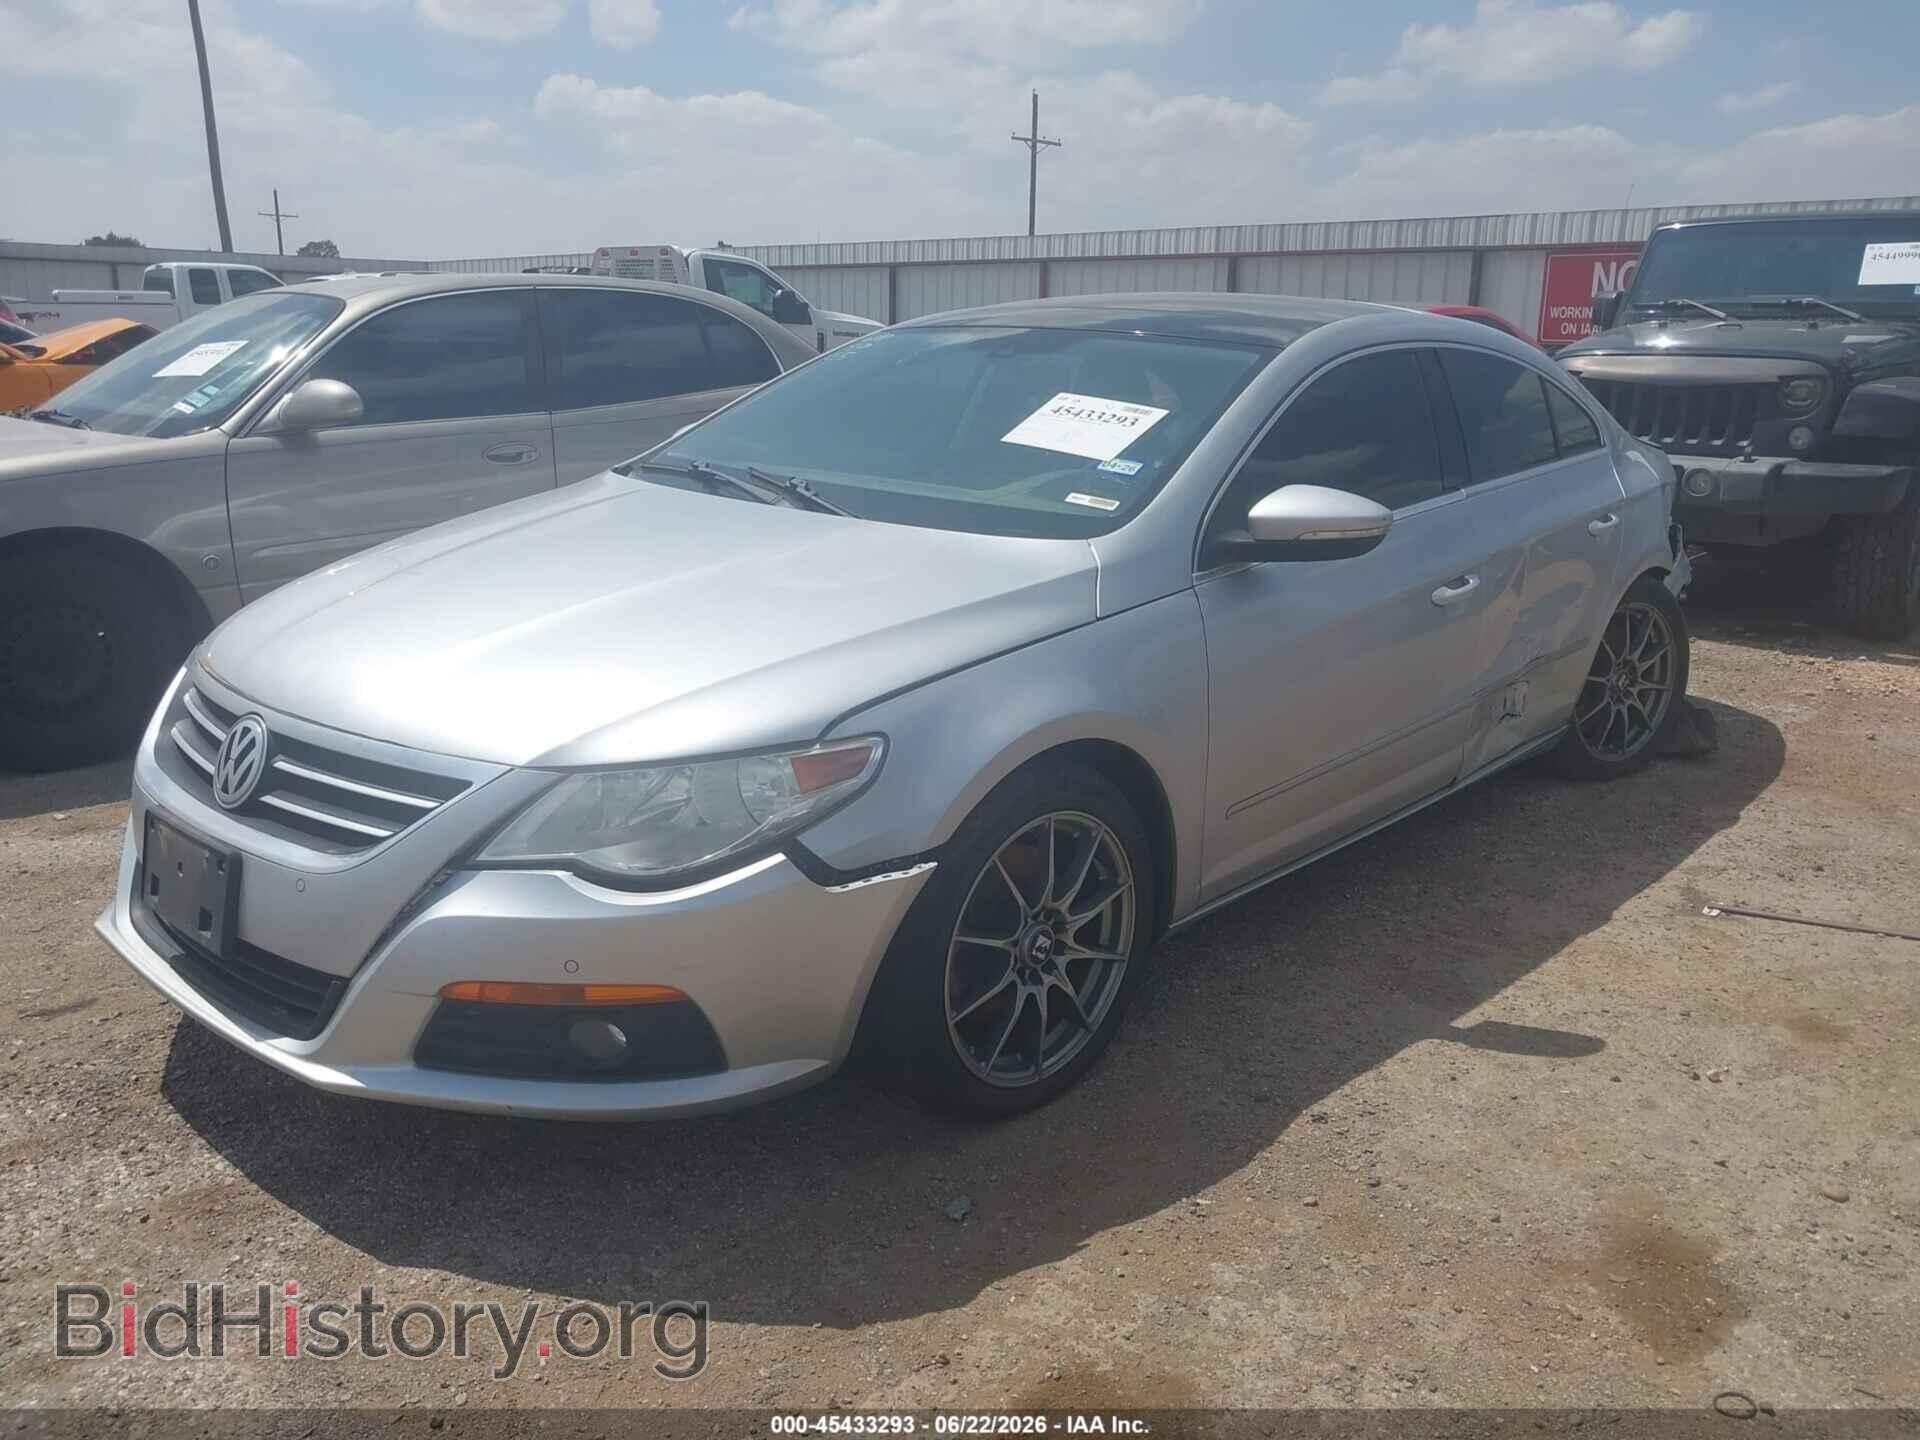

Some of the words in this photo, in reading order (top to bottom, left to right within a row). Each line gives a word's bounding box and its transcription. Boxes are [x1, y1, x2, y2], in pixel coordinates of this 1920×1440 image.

[1550, 305, 1593, 319] WORKIN
[1560, 322, 1577, 335] ON
[1049, 405, 1140, 428] 45433293
